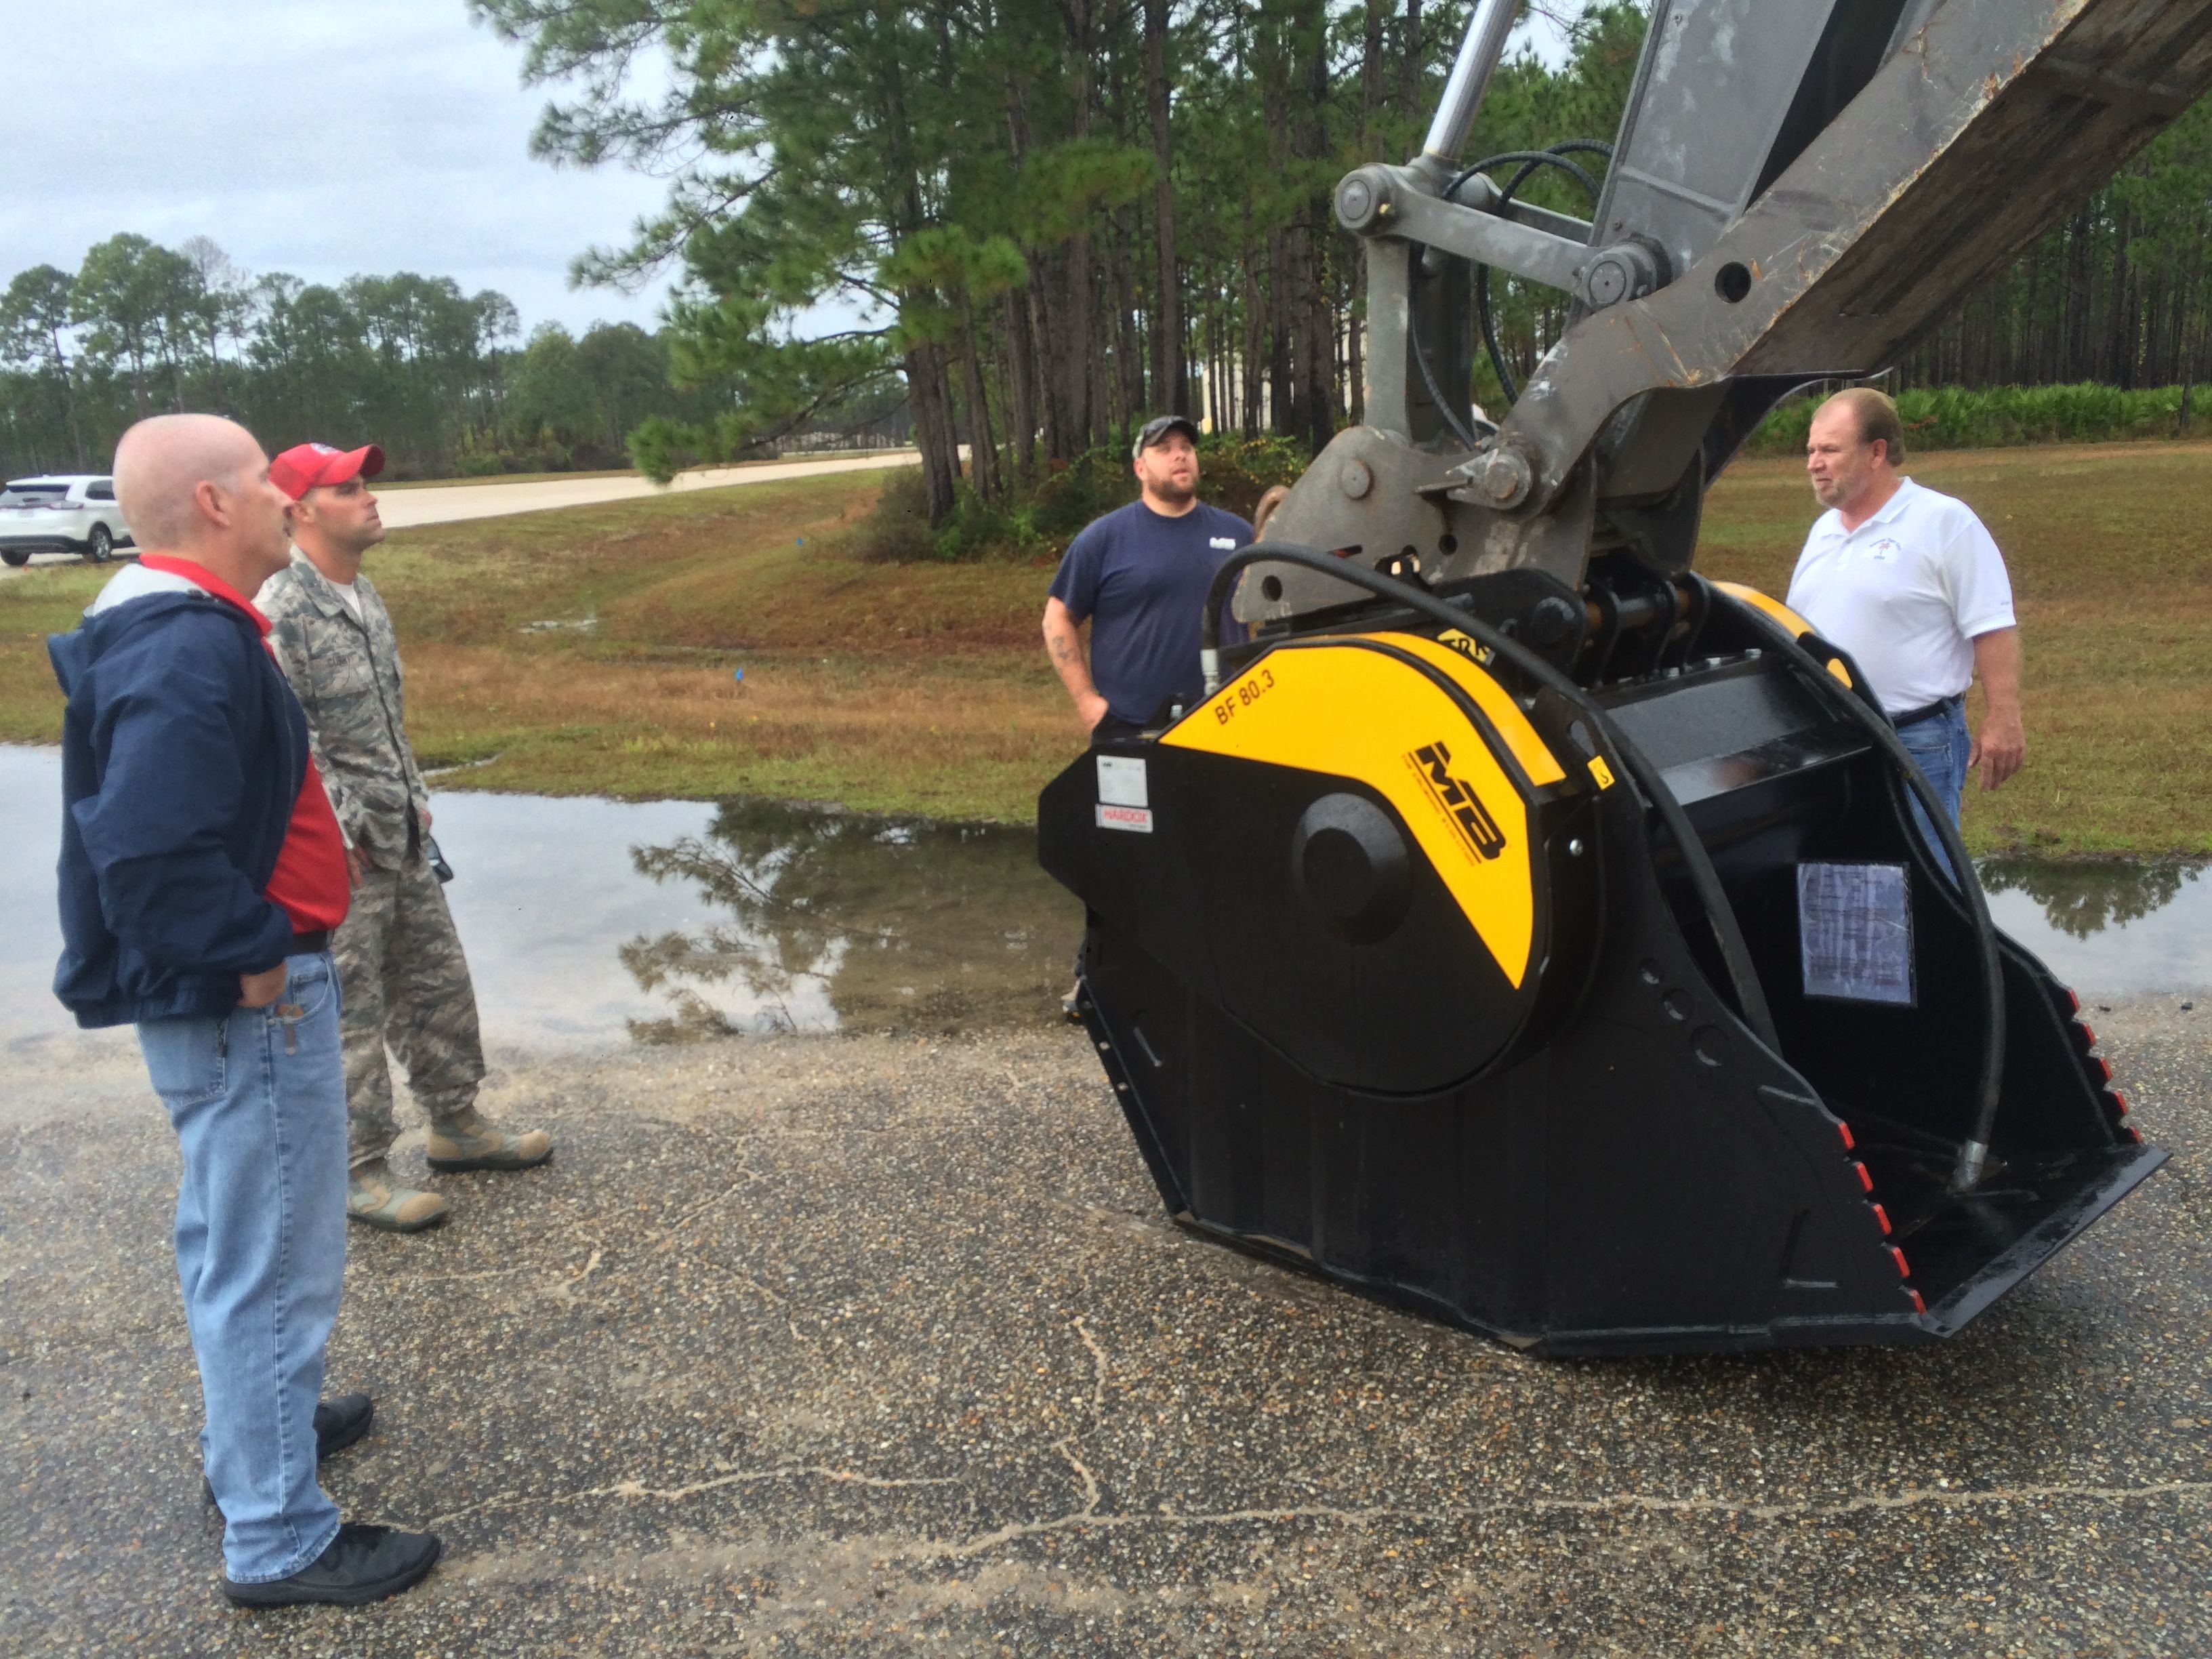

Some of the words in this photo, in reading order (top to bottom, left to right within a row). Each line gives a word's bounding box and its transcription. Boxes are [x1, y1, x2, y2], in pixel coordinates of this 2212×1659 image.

[1215, 696, 1235, 725] BF
[1239, 669, 1275, 706] 80.3
[1415, 741, 1506, 860] MB
